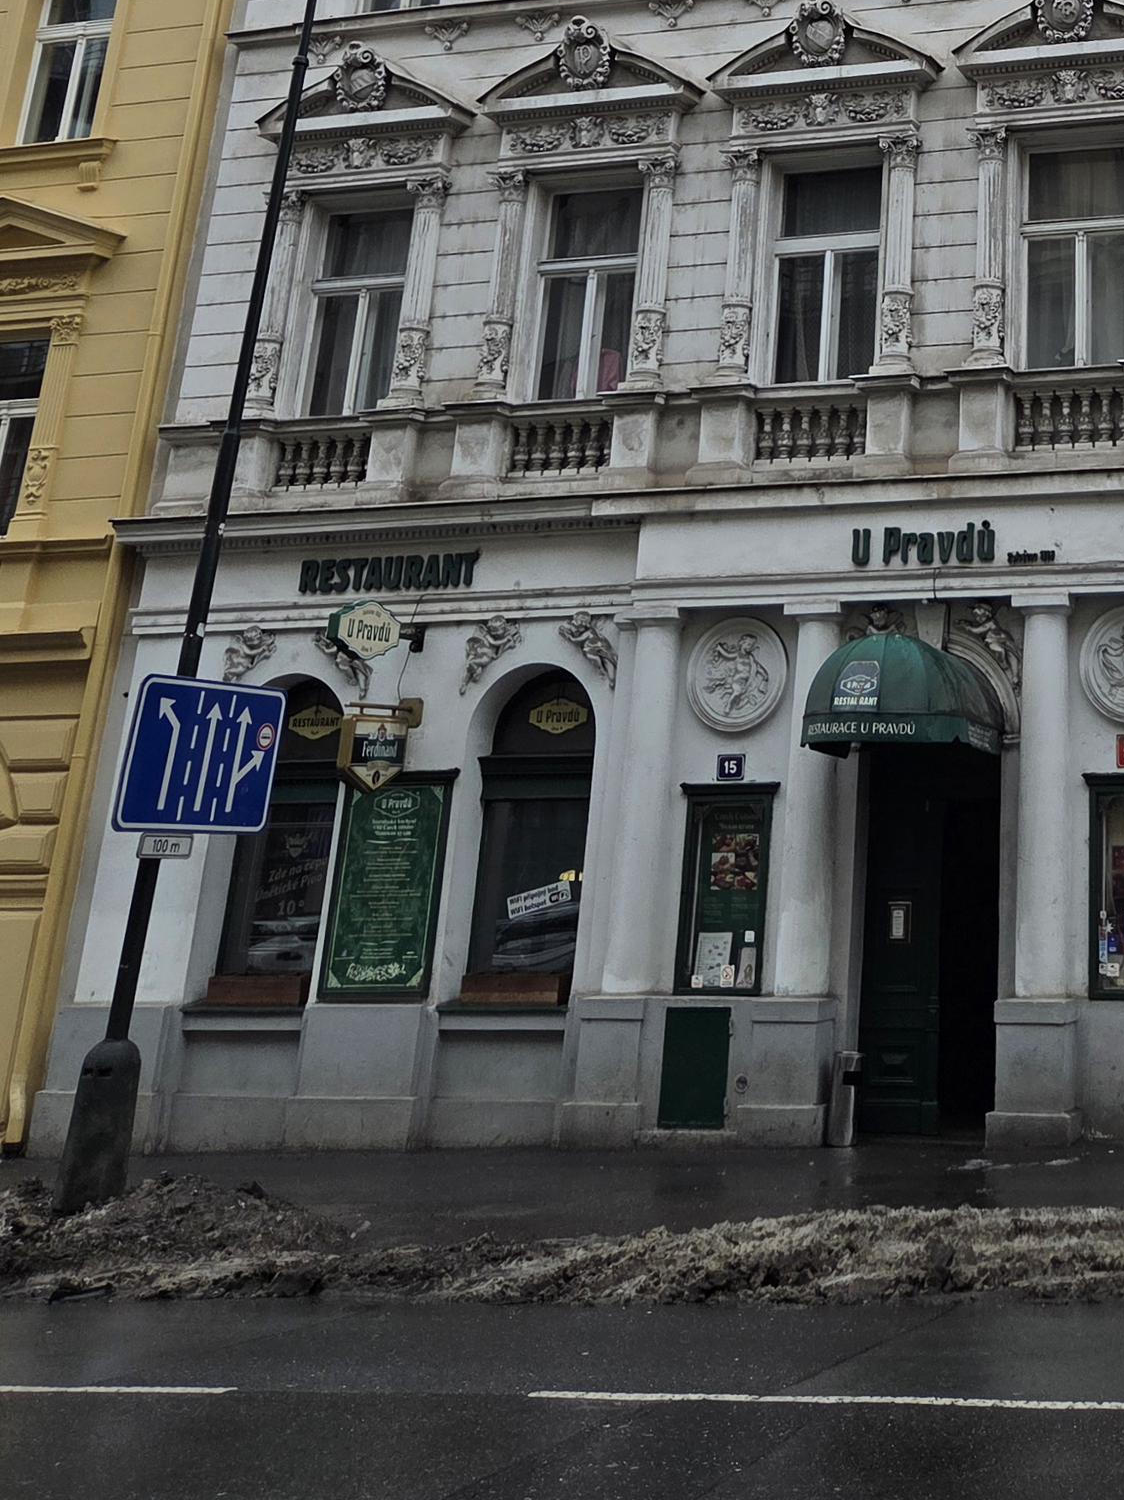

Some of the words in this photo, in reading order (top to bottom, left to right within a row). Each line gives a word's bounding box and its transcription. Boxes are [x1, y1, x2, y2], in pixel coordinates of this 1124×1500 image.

[852, 528, 871, 567] U
[882, 520, 996, 566] Pravdů
[298, 549, 483, 594] RESTAURANT
[347, 618, 356, 638] U
[356, 620, 391, 643] Pravdů
[292, 716, 340, 729] RESTAURANT
[536, 709, 543, 723] U
[545, 707, 580, 723] Pravdů
[807, 721, 857, 736] RESTAURACE
[860, 722, 869, 734] U
[872, 720, 916, 735] PRAVDŮ
[361, 741, 398, 758] Ferdinand
[724, 760, 737, 774] 15
[152, 839, 169, 853] 100
[170, 843, 180, 853] m
